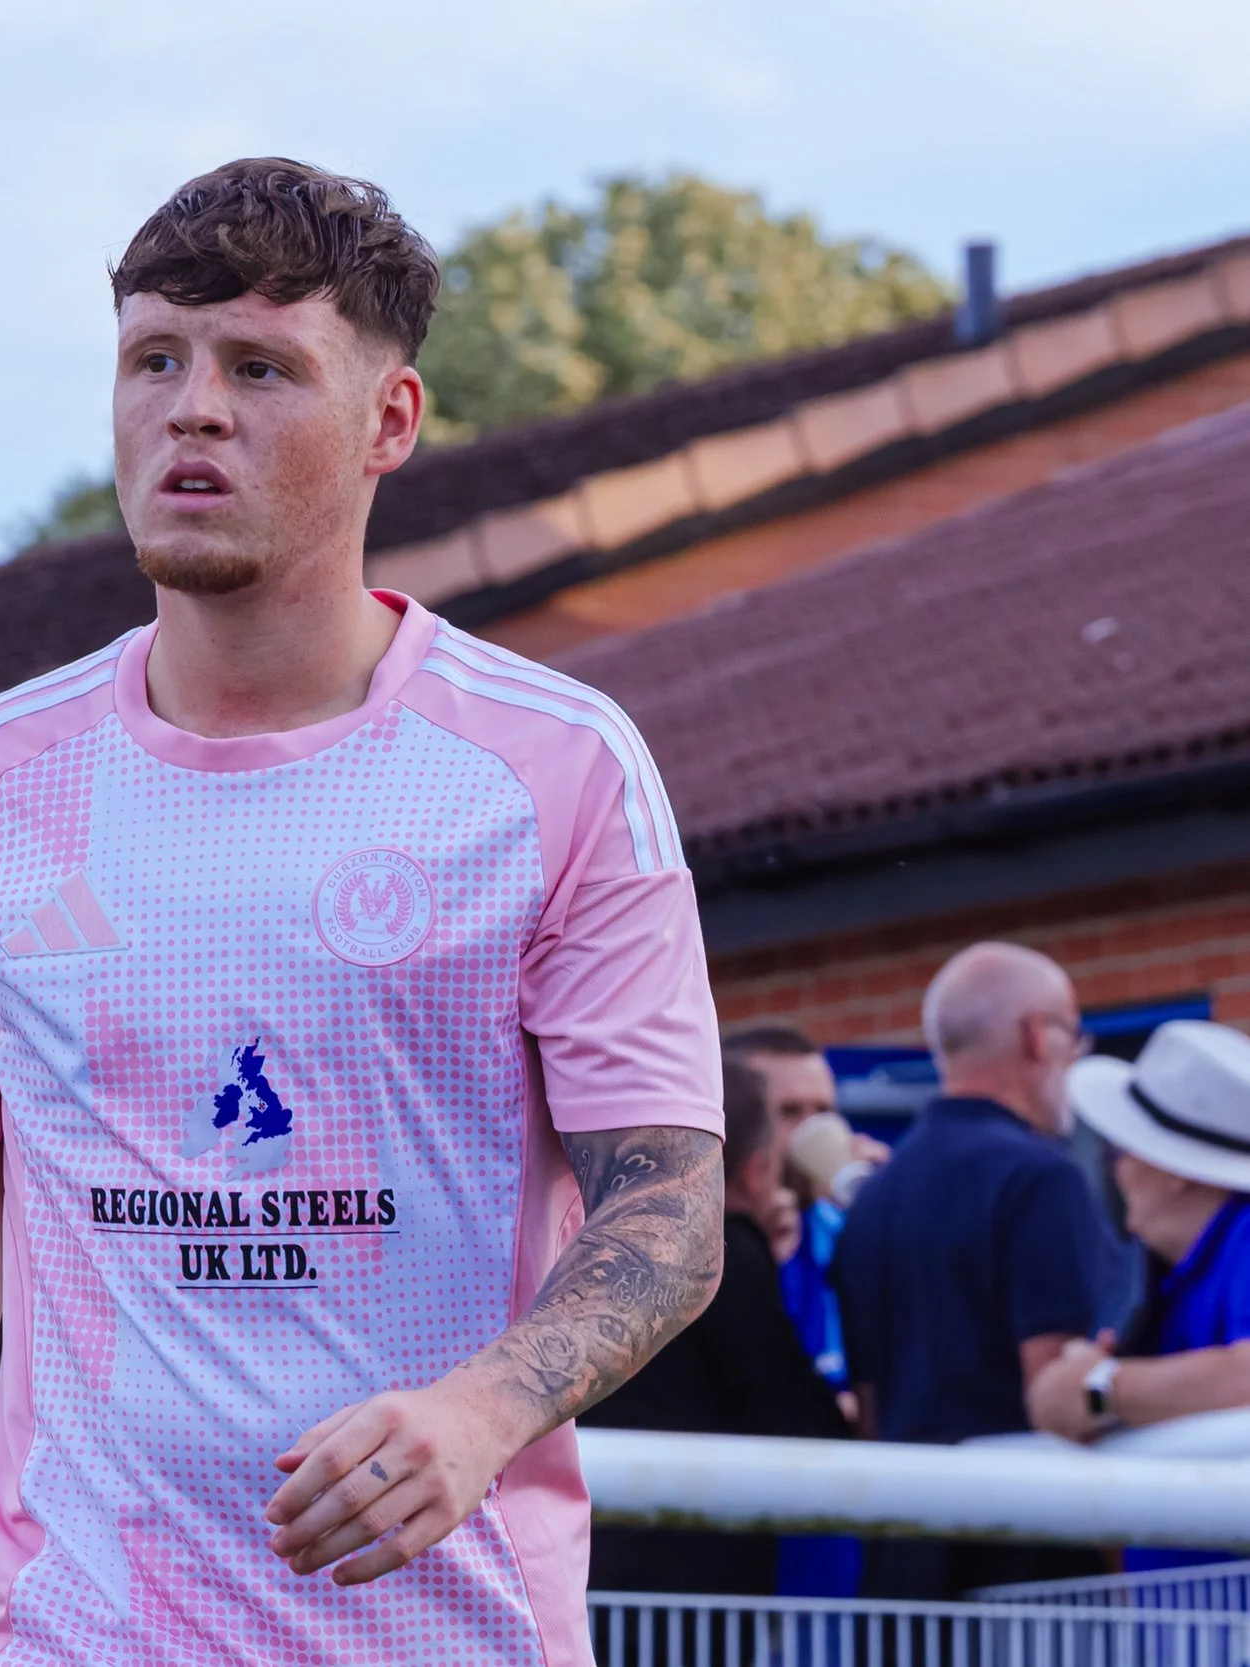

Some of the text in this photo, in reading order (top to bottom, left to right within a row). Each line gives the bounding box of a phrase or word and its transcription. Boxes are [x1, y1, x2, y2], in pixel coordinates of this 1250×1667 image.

[327, 852, 428, 897] CURZON ASHTON
[324, 917, 422, 958] FOOTBALL CLUB
[91, 1187, 396, 1229] REGIONAL STEELS
[179, 1243, 317, 1281] UK LTD.
